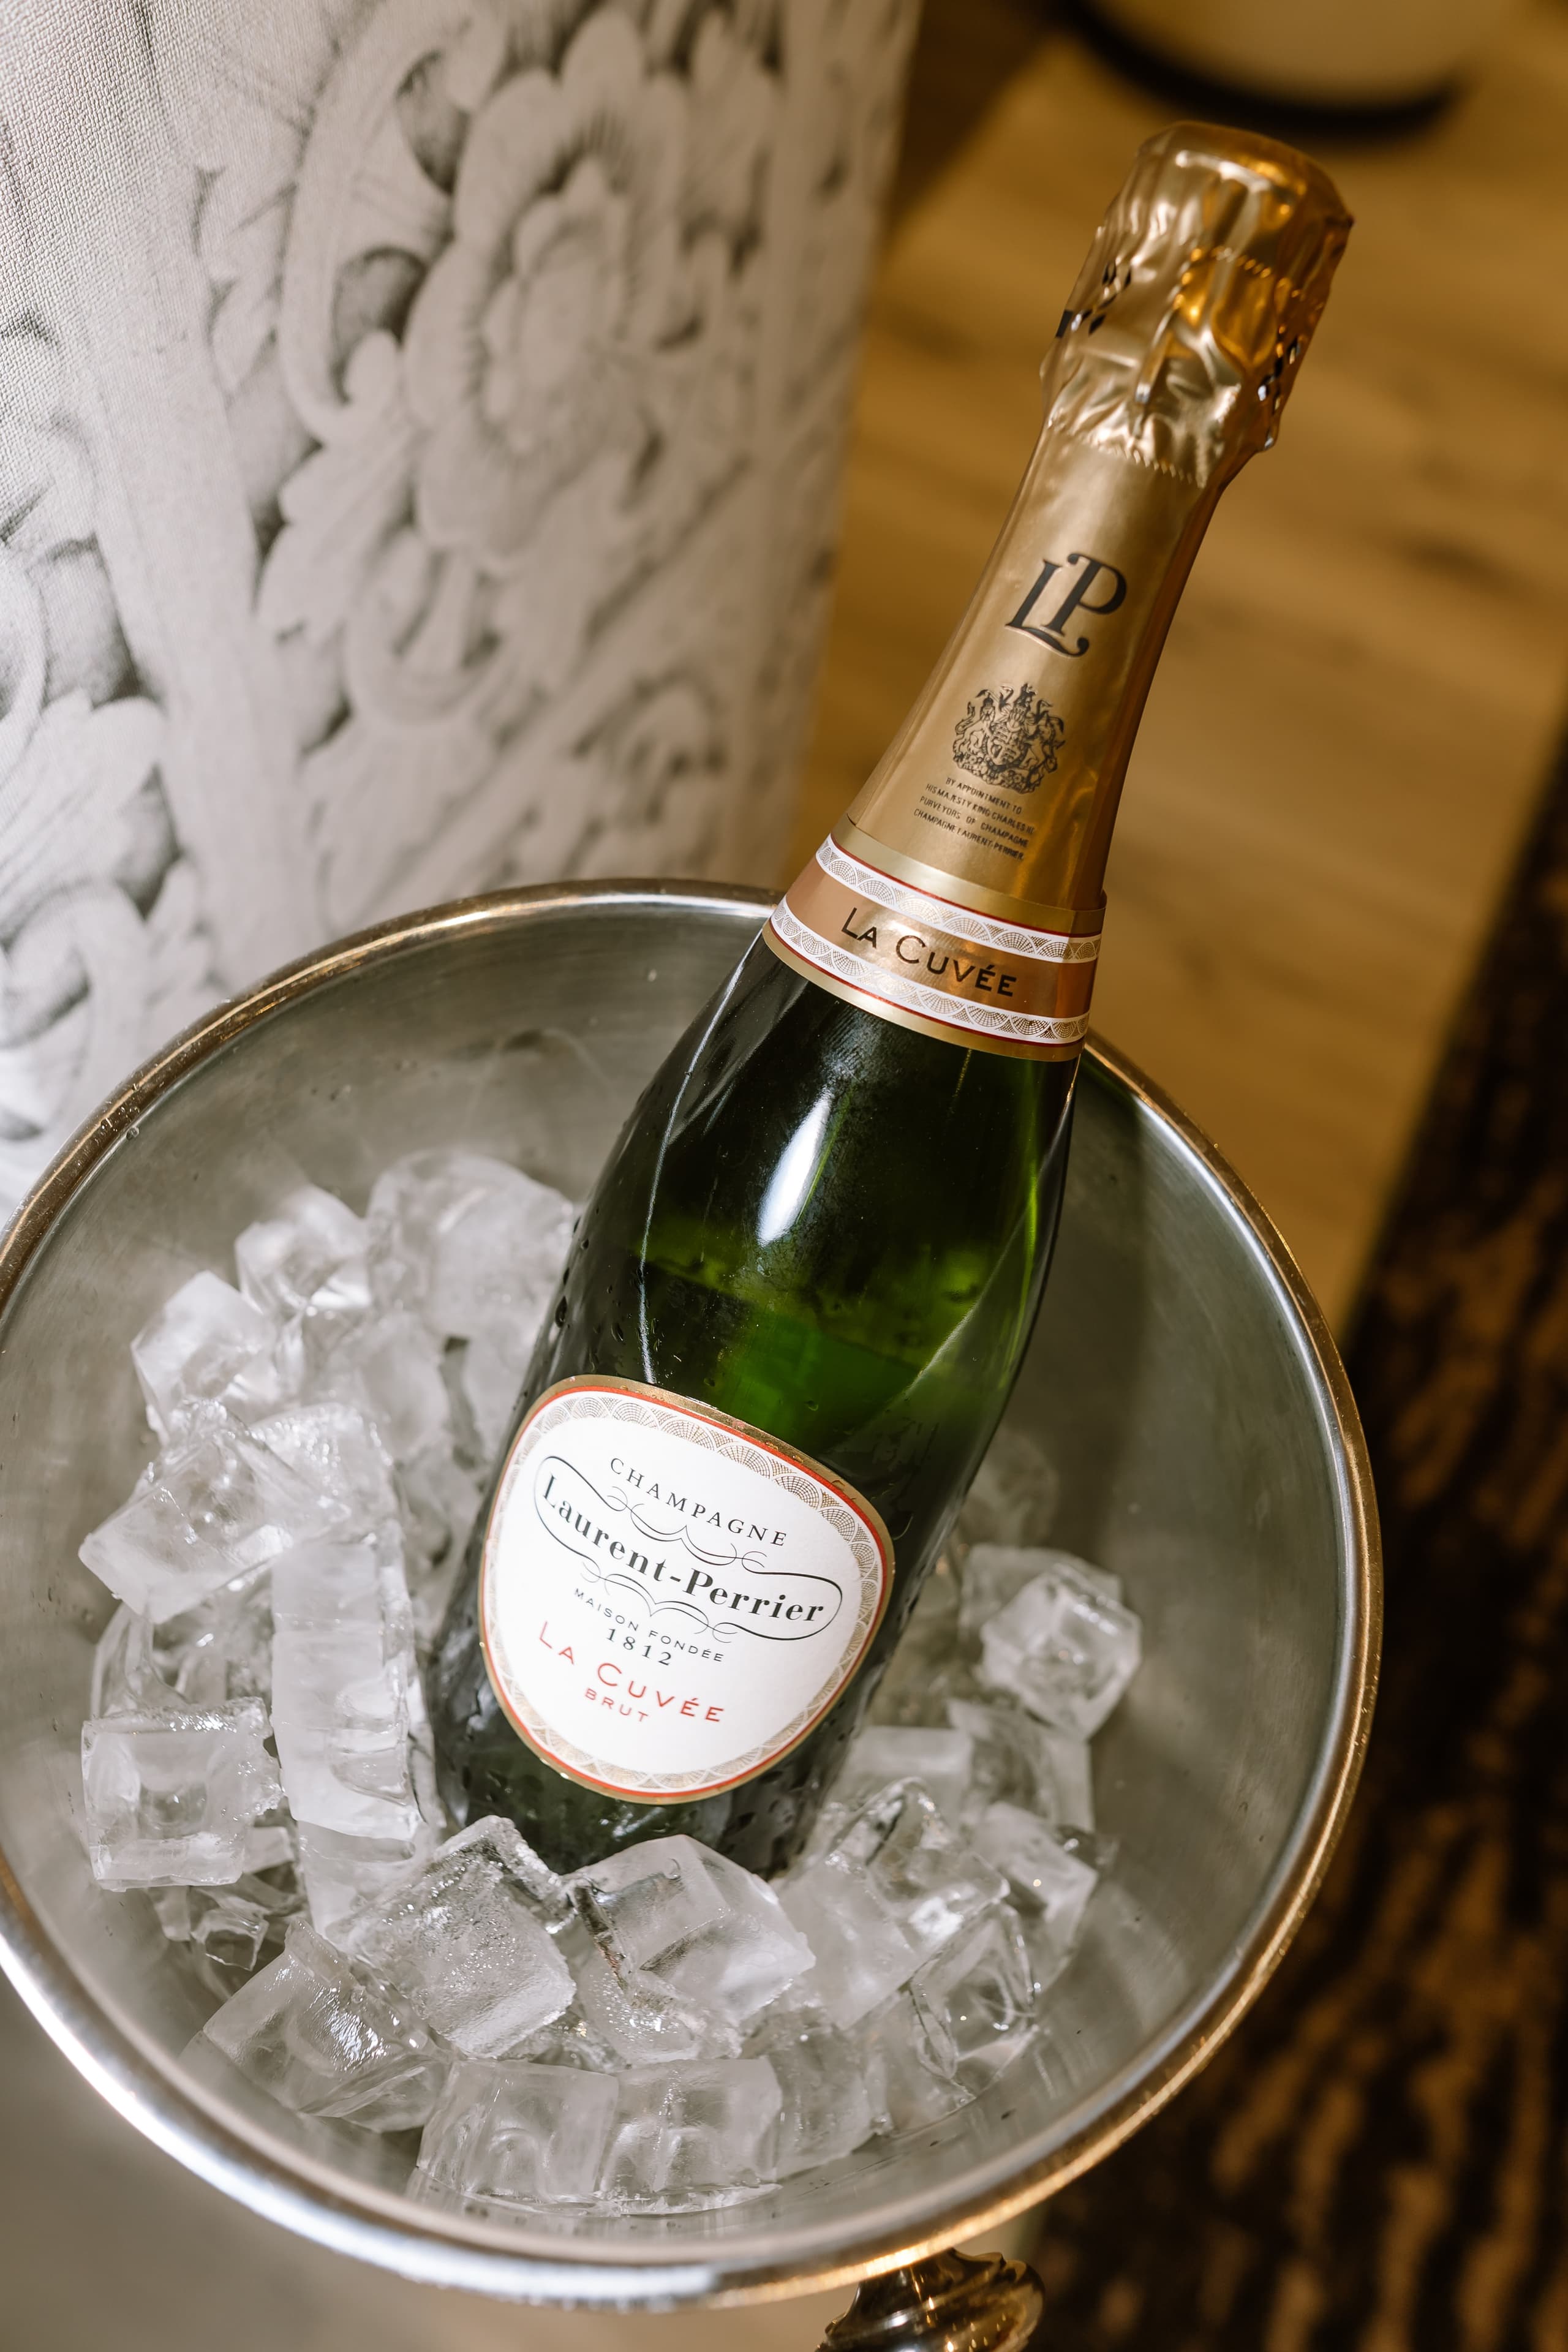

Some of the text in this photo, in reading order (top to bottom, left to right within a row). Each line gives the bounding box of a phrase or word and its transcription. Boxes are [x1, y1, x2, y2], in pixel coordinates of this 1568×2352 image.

[914, 809, 956, 832] CHAMPAGNE
[919, 796, 1028, 848] PURVEYORS OF CHAMPAGNE
[925, 783, 937, 794] HIS
[992, 812, 1025, 832] CHARLES
[946, 778, 1022, 815] BY APPOINTMENT TO
[841, 907, 1017, 997] LA CUVÉE
[610, 1457, 787, 1547] CHAMPAGNE
[541, 1473, 824, 1623] Laurent-Perrier
[574, 1588, 725, 1662] MAISON FONDÉE
[606, 1628, 672, 1666] 1812
[539, 1621, 725, 1722] LA CUVÉE
[584, 1688, 649, 1723] BRUT
